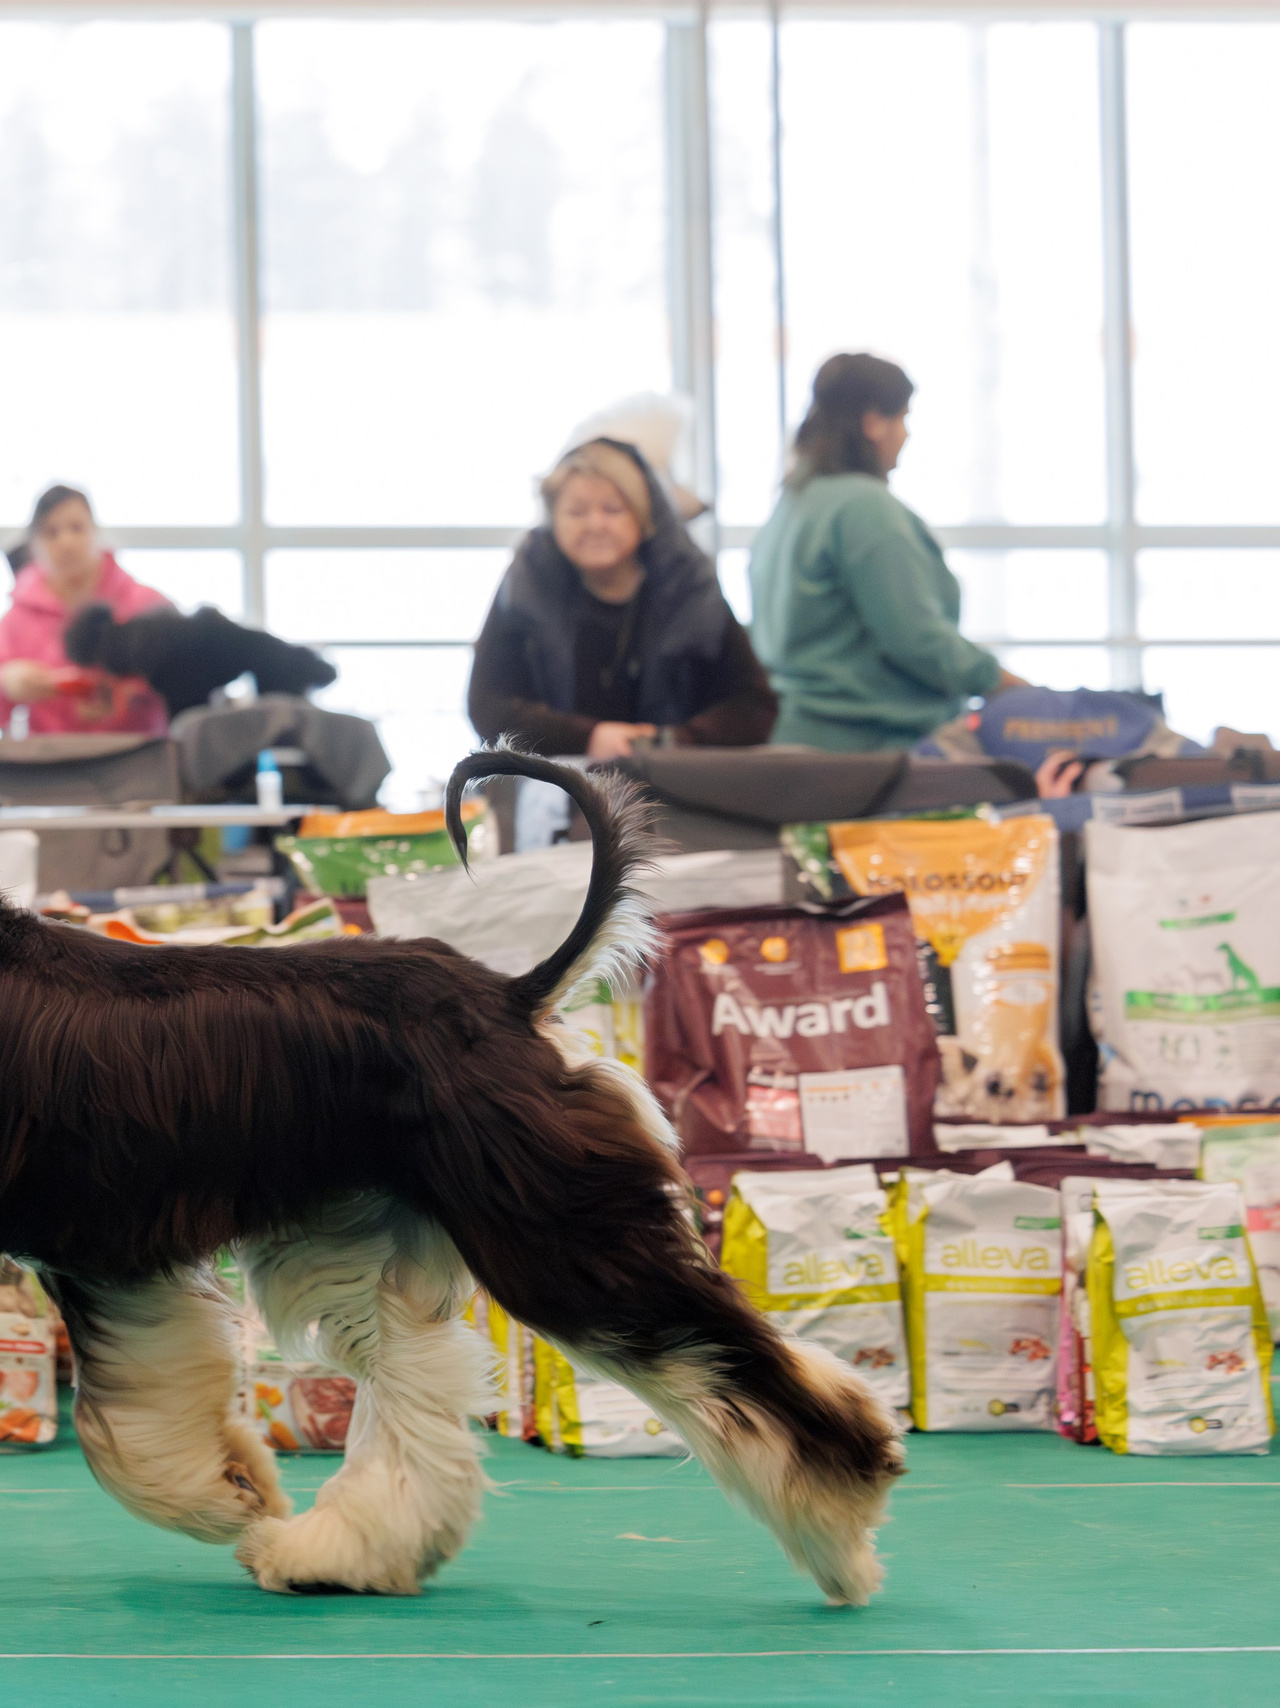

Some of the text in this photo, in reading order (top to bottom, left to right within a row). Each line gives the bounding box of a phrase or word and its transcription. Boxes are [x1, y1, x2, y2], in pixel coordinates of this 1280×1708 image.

[711, 981, 891, 1039] Award
[781, 1251, 886, 1287] alleva
[940, 1238, 1050, 1271] alleva
[1124, 1255, 1238, 1290] alleva
